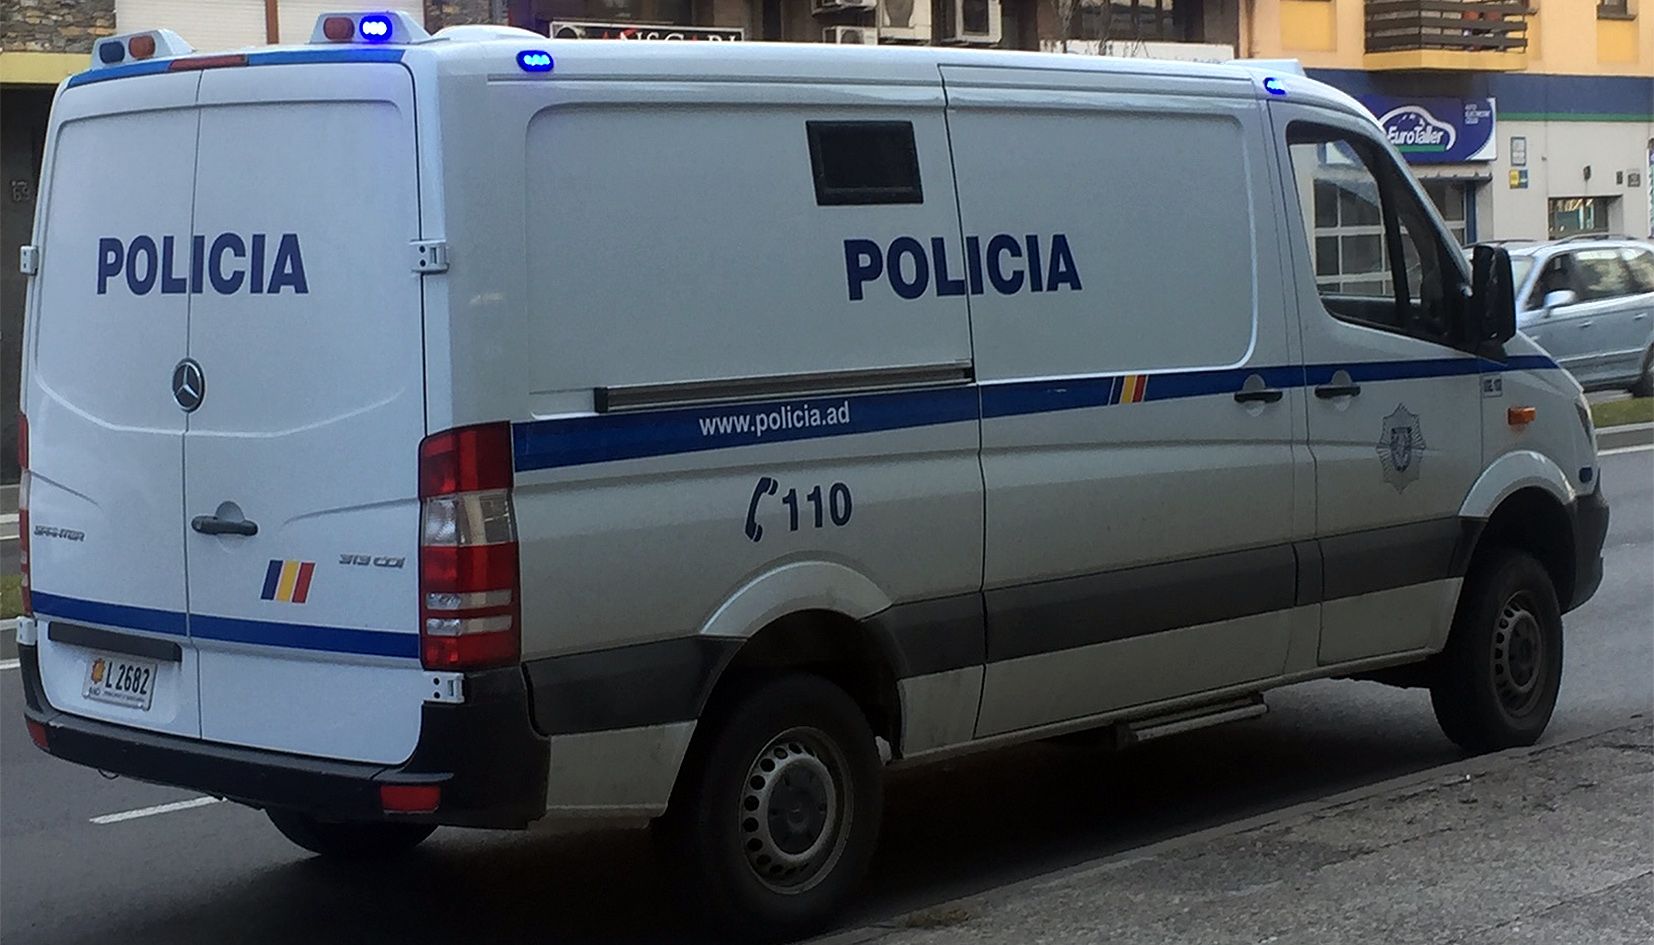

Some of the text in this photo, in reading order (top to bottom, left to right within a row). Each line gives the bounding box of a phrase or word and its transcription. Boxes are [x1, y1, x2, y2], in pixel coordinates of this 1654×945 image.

[1387, 123, 1443, 144] EuroTaller
[97, 232, 309, 295] POLICIA
[843, 234, 1082, 301] POLICIA
[699, 400, 850, 437] www.policia.ad
[782, 482, 852, 531] 110
[339, 554, 405, 569] 313 CDI
[105, 661, 150, 695] L 2682
